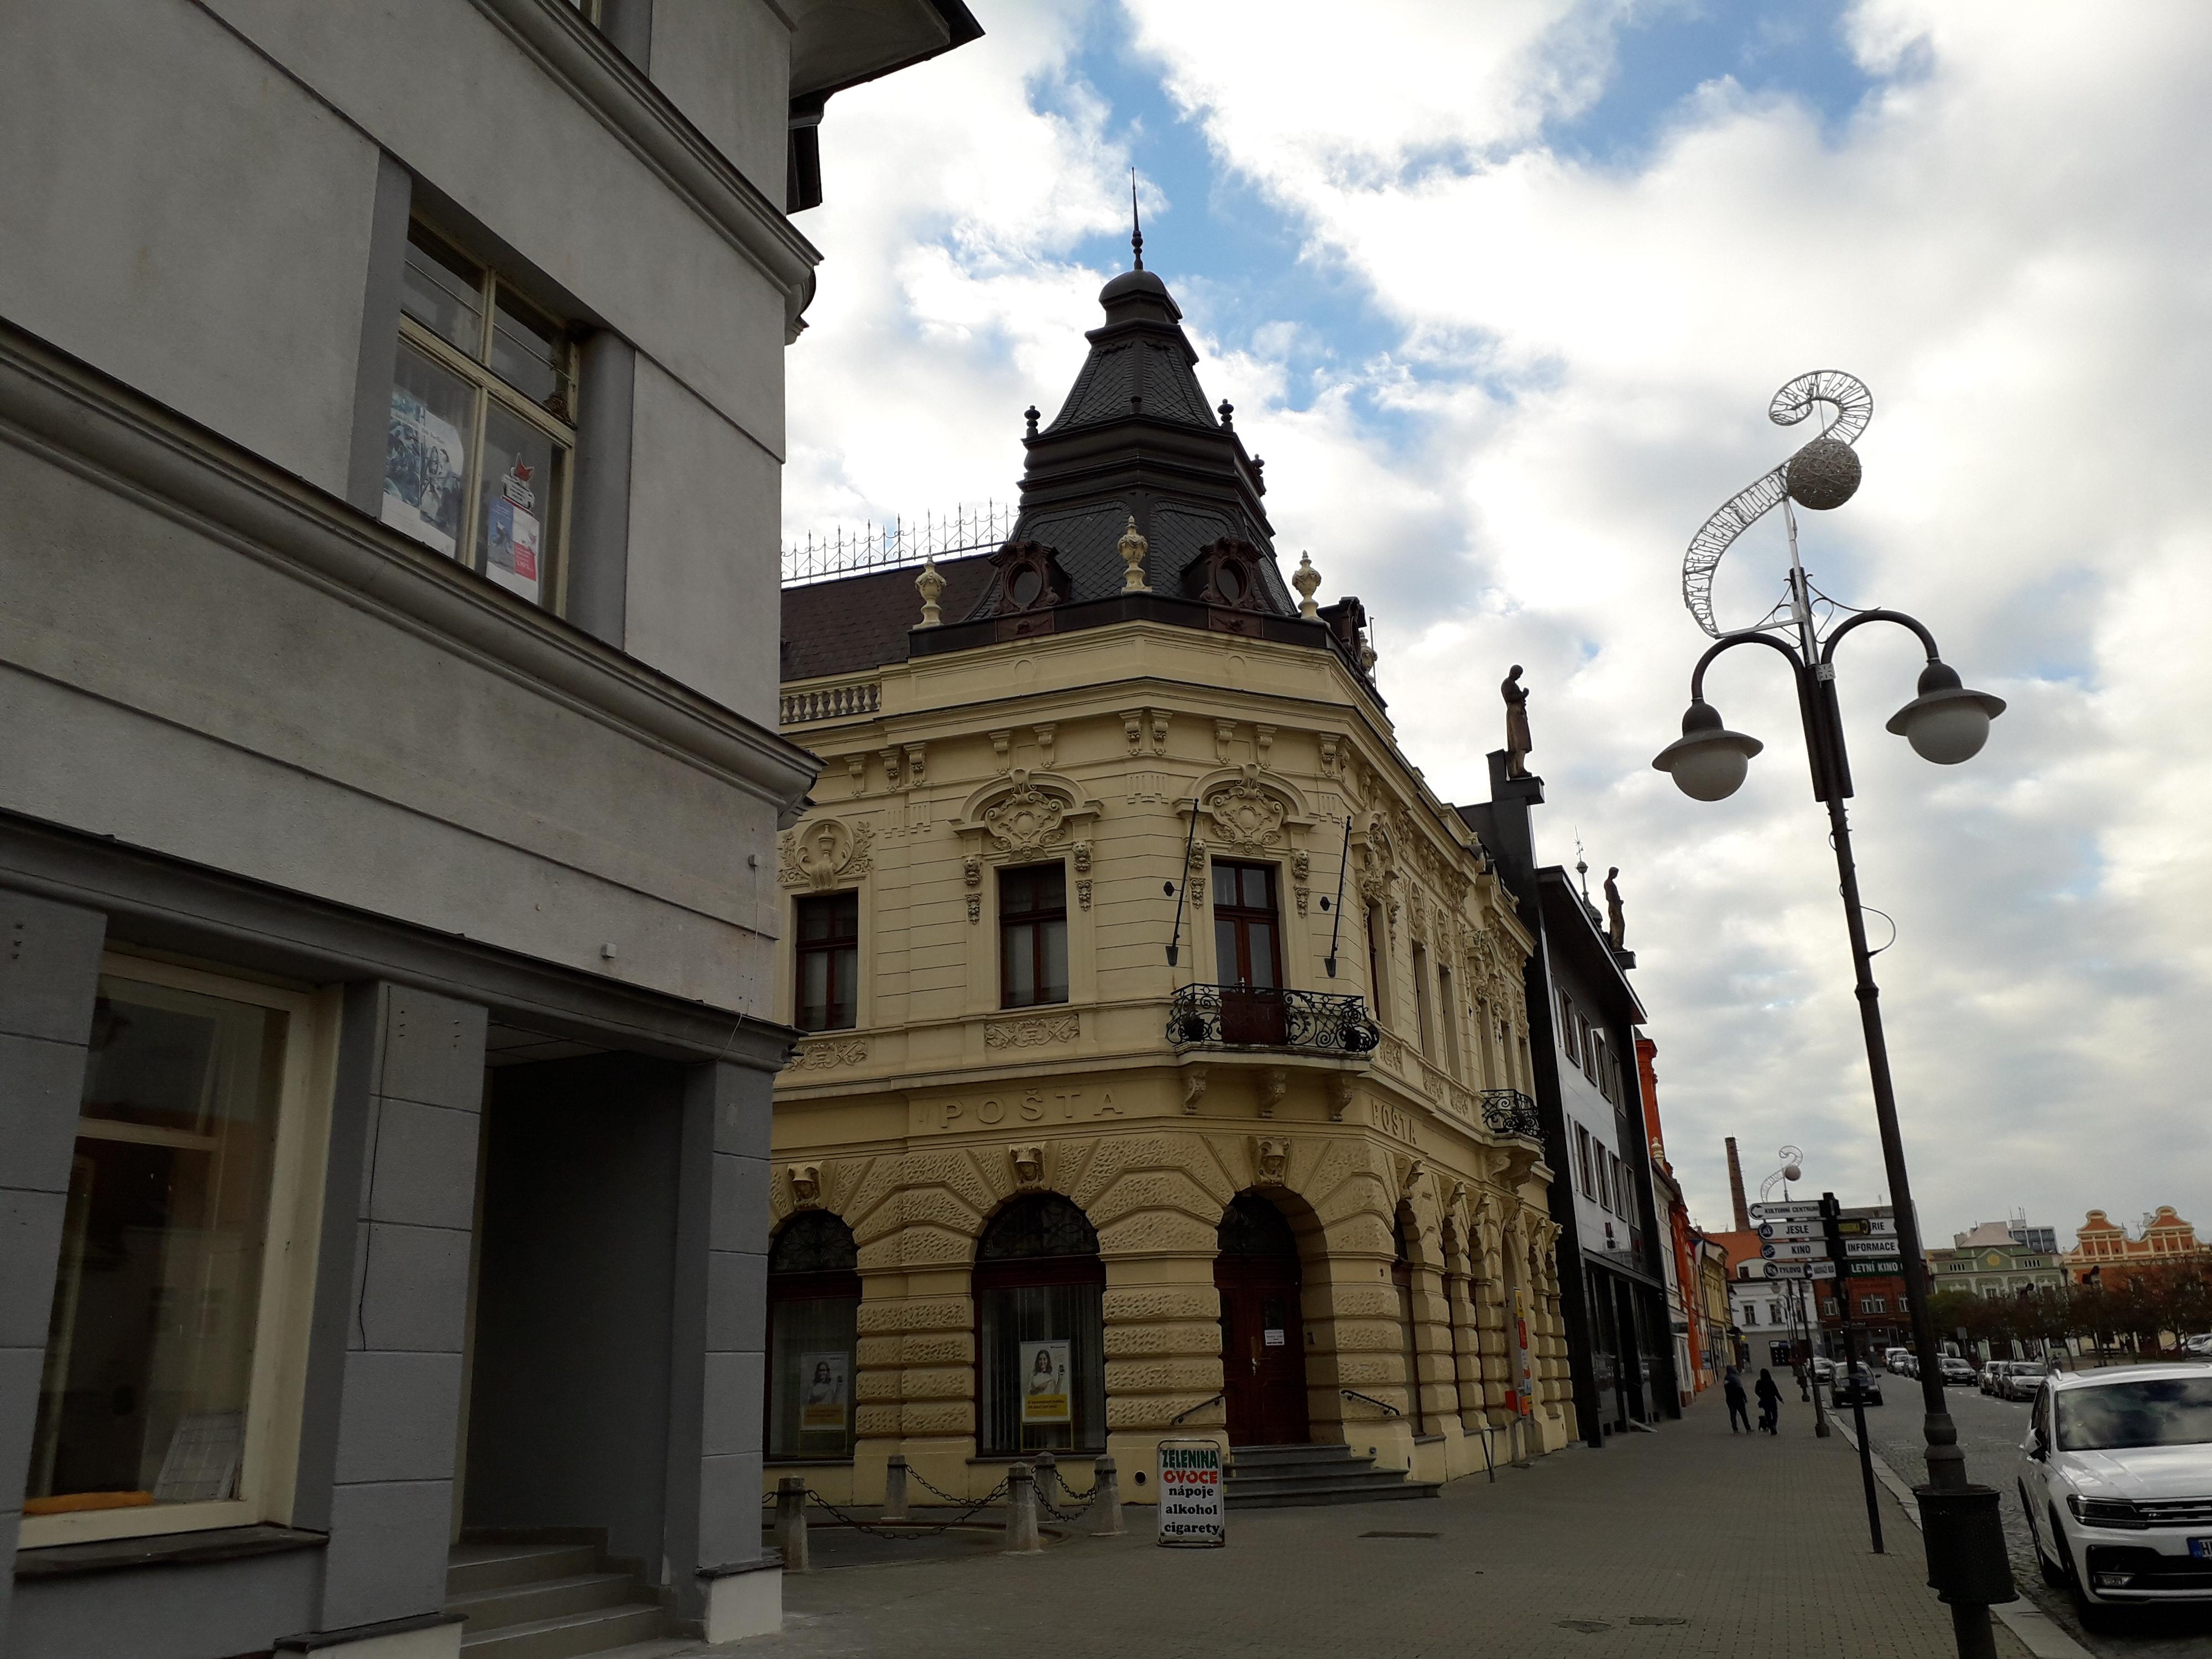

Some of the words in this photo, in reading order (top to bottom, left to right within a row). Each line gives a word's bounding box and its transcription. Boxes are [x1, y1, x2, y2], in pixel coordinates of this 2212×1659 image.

[940, 1086, 1124, 1129] POŠTA
[1785, 1224, 1809, 1234] JESLE
[1791, 1245, 1811, 1254] KINO
[1847, 1242, 1896, 1252] INFORMACE
[1850, 1260, 1875, 1274] LETNÍ
[1877, 1261, 1898, 1272] KINO
[1162, 1449, 1219, 1469] ZELENINA
[1164, 1470, 1218, 1484] OVOCE
[1168, 1485, 1214, 1499] nápoje
[1165, 1504, 1218, 1515] alkohol
[1164, 1521, 1220, 1535] cigarety
